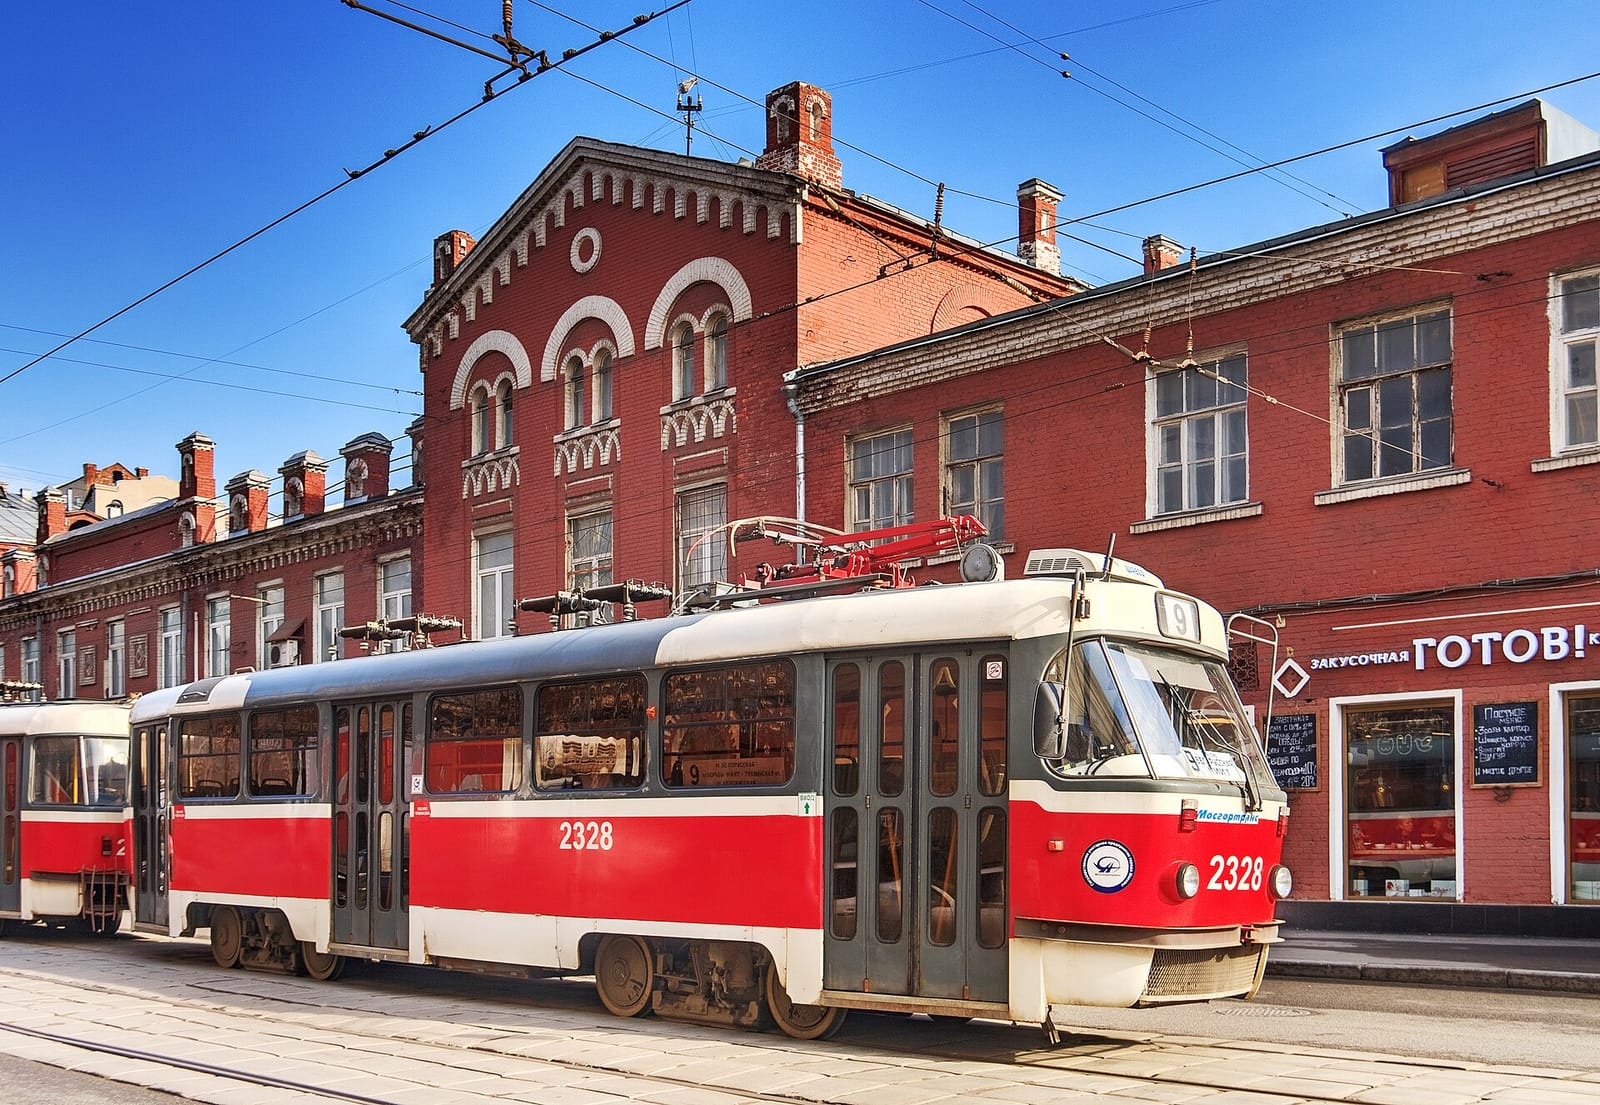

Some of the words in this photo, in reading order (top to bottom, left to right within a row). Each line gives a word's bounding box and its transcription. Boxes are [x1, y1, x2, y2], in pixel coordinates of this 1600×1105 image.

[1173, 603, 1187, 636] 9
[1310, 650, 1410, 670] ЗАКУСОЧНАЯ
[1412, 624, 1585, 671] ГОТОВ!
[690, 764, 700, 785] 9
[1184, 750, 1200, 771] 9
[559, 821, 614, 850] 2328
[1206, 854, 1264, 892] 2328
